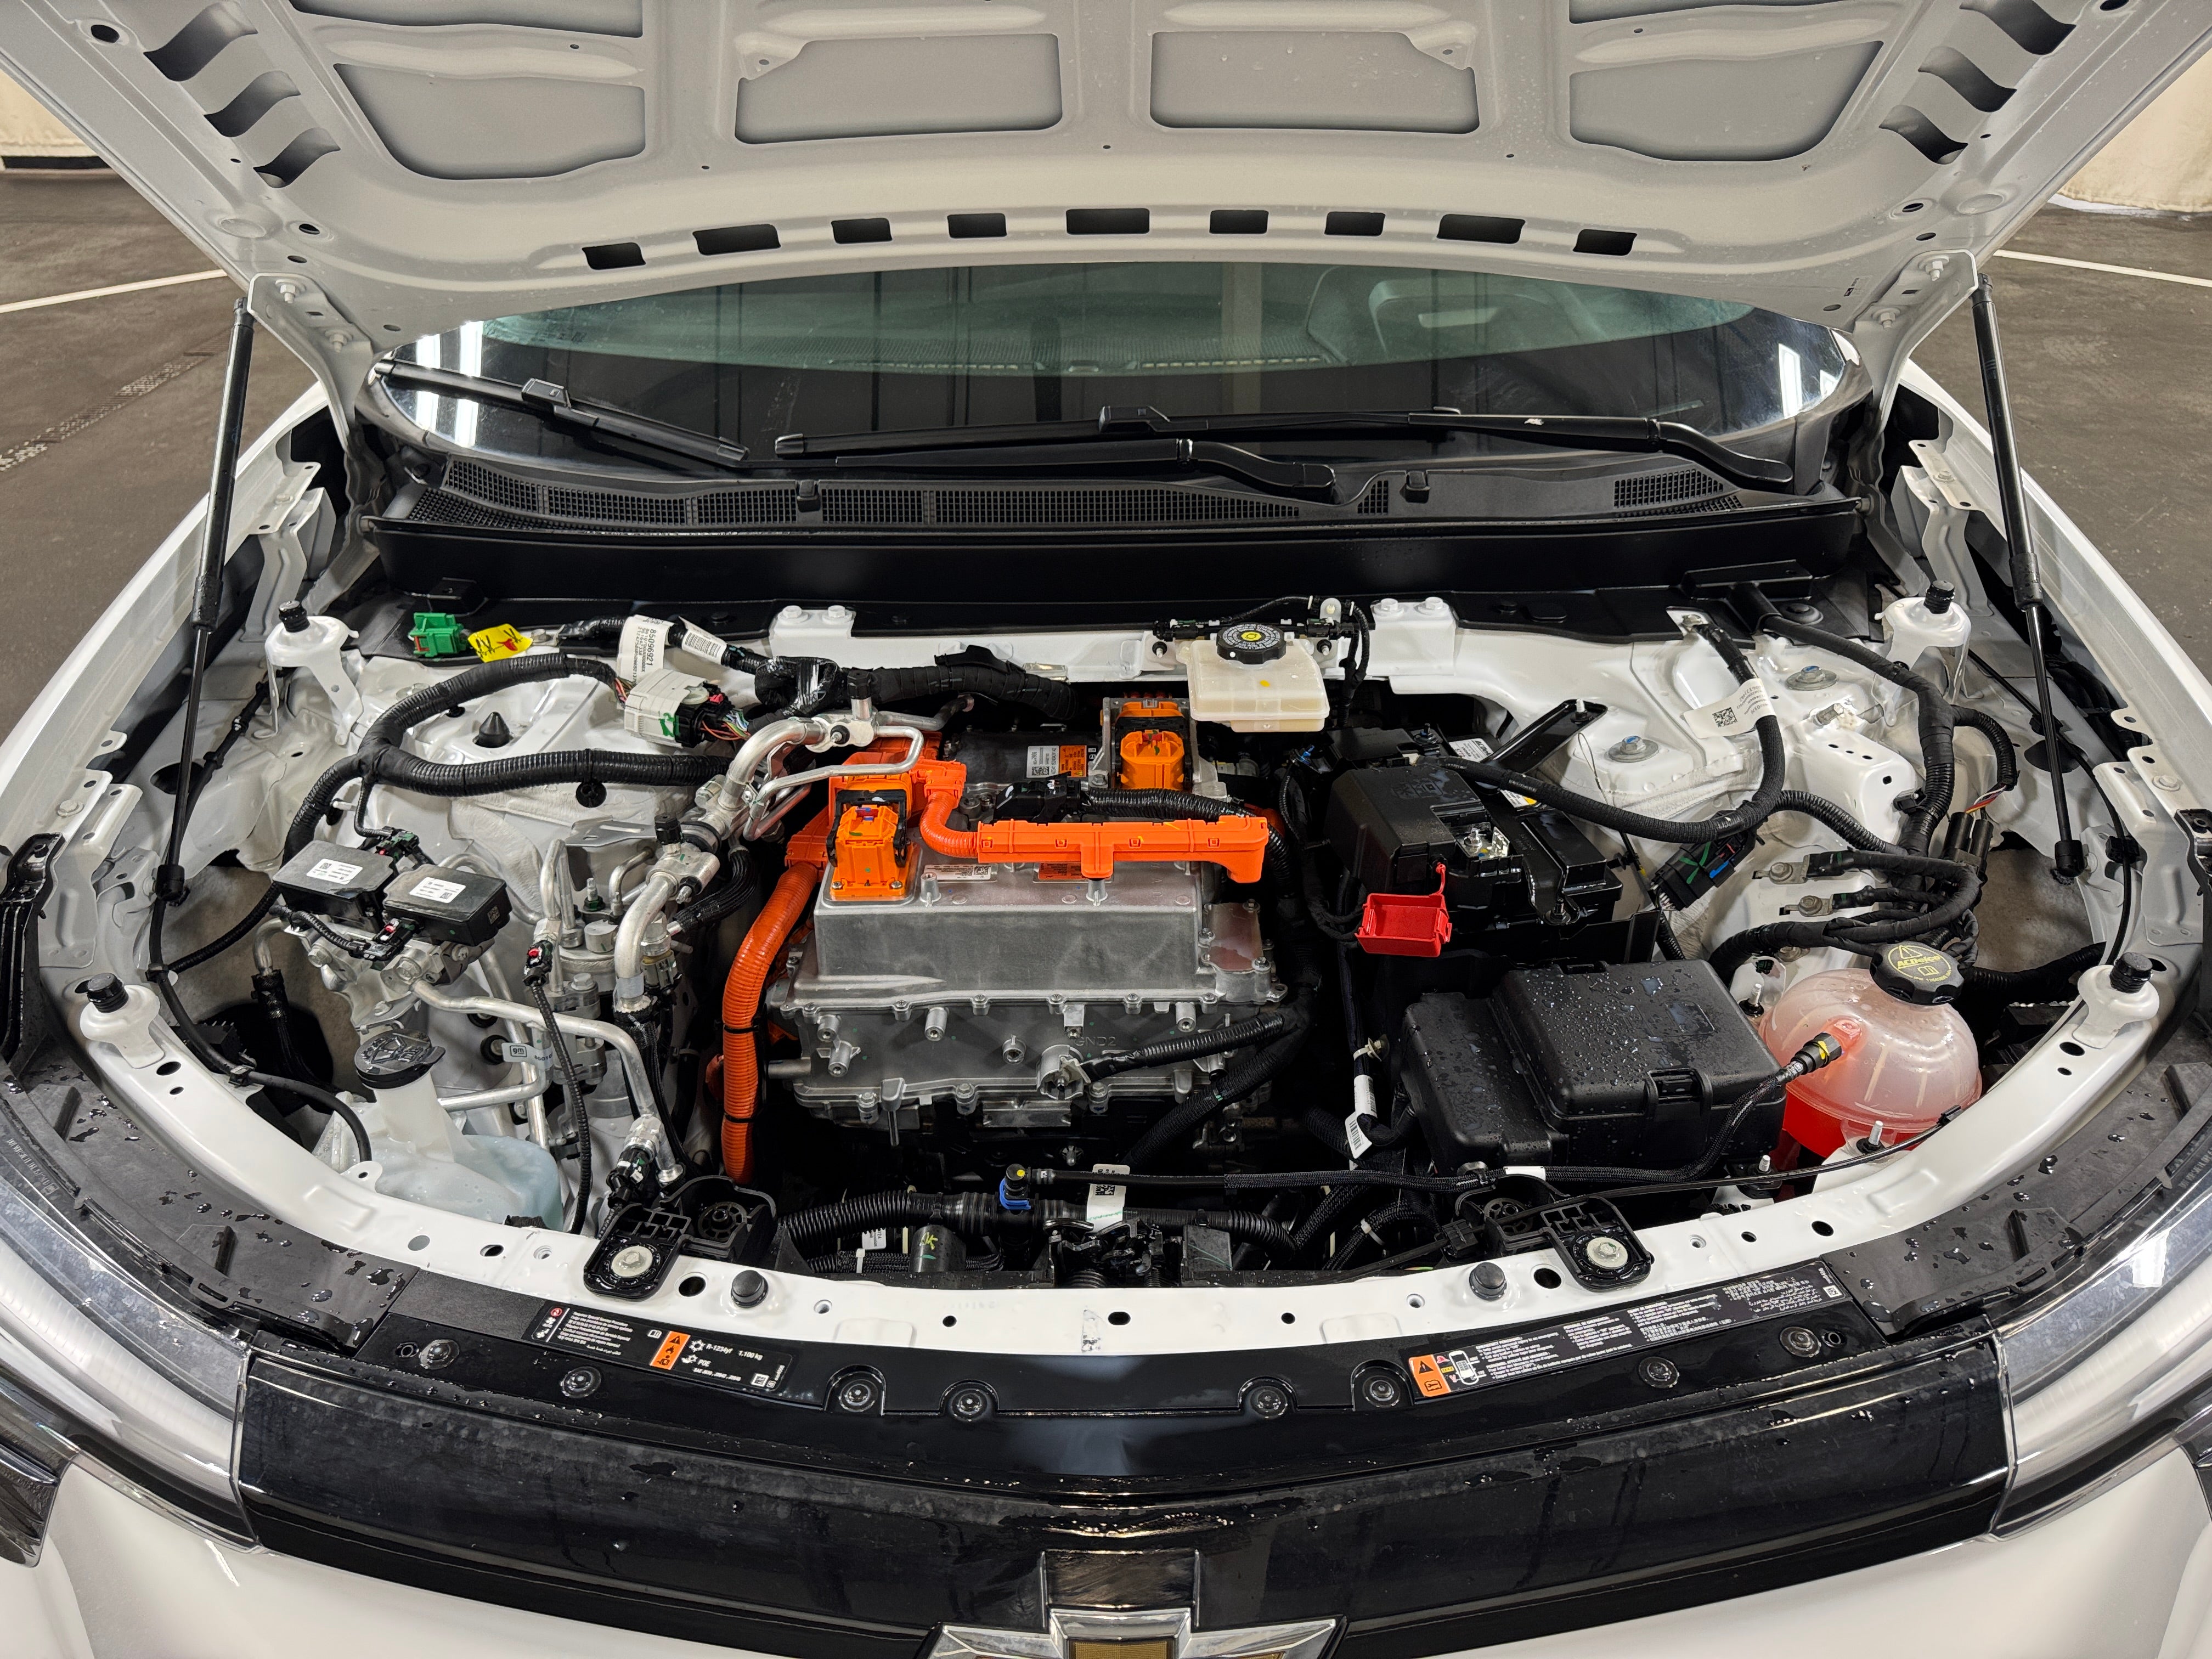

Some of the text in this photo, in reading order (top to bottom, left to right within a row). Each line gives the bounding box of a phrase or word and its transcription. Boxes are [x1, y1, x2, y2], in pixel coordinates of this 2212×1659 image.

[646, 629, 657, 666] 85096921
[1897, 955, 1941, 967] ACDelco
[1075, 1036, 1116, 1046] GND2
[706, 1344, 733, 1355] R-1234yf
[697, 1359, 712, 1367] POE
